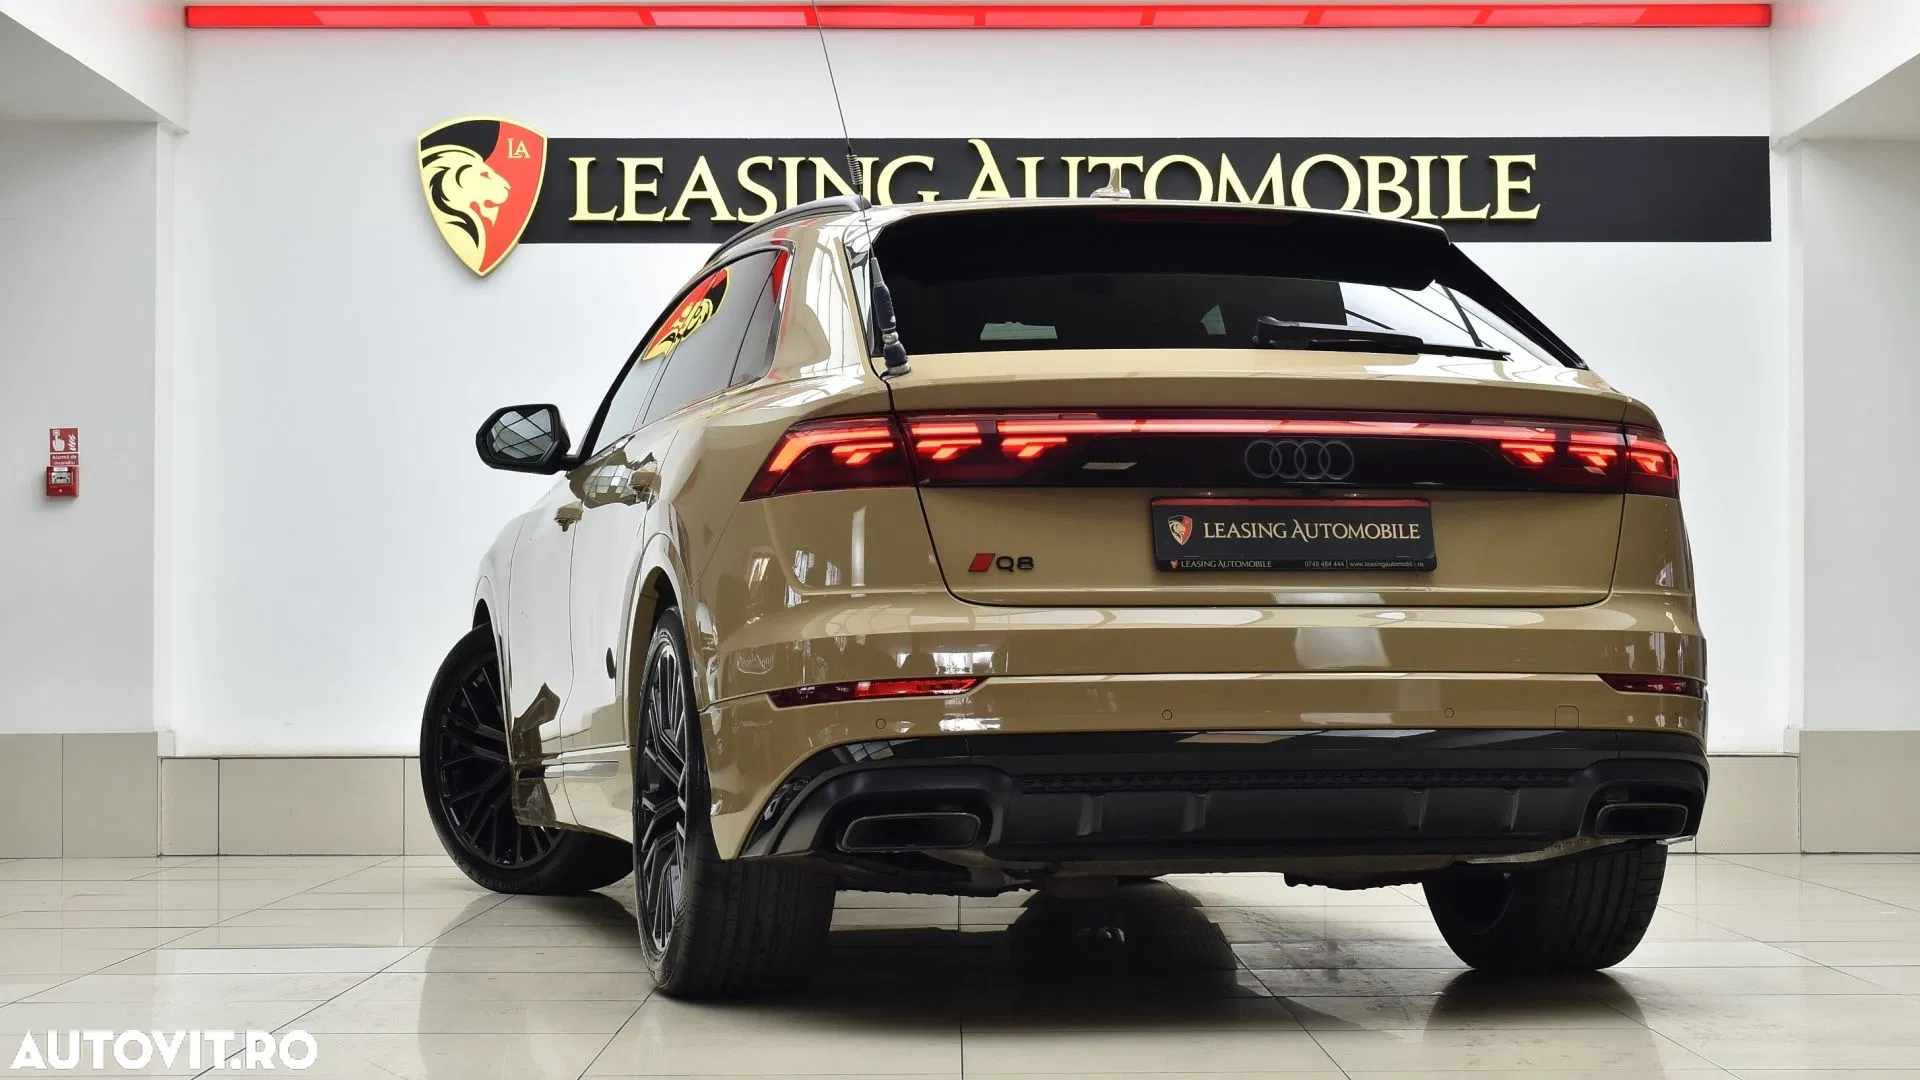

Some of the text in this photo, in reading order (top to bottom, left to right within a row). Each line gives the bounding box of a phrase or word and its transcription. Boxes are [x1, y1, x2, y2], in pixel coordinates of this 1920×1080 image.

[507, 137, 531, 159] LA
[568, 138, 1541, 223] LEASING AUTOMOBILE
[1203, 518, 1421, 543] LEASING AUTOMOBILE
[995, 555, 1035, 573] Q8
[1180, 559, 1273, 569] LEASING AUTOMOBILE
[1304, 560, 1320, 568] 0748
[1333, 560, 1345, 568] 444
